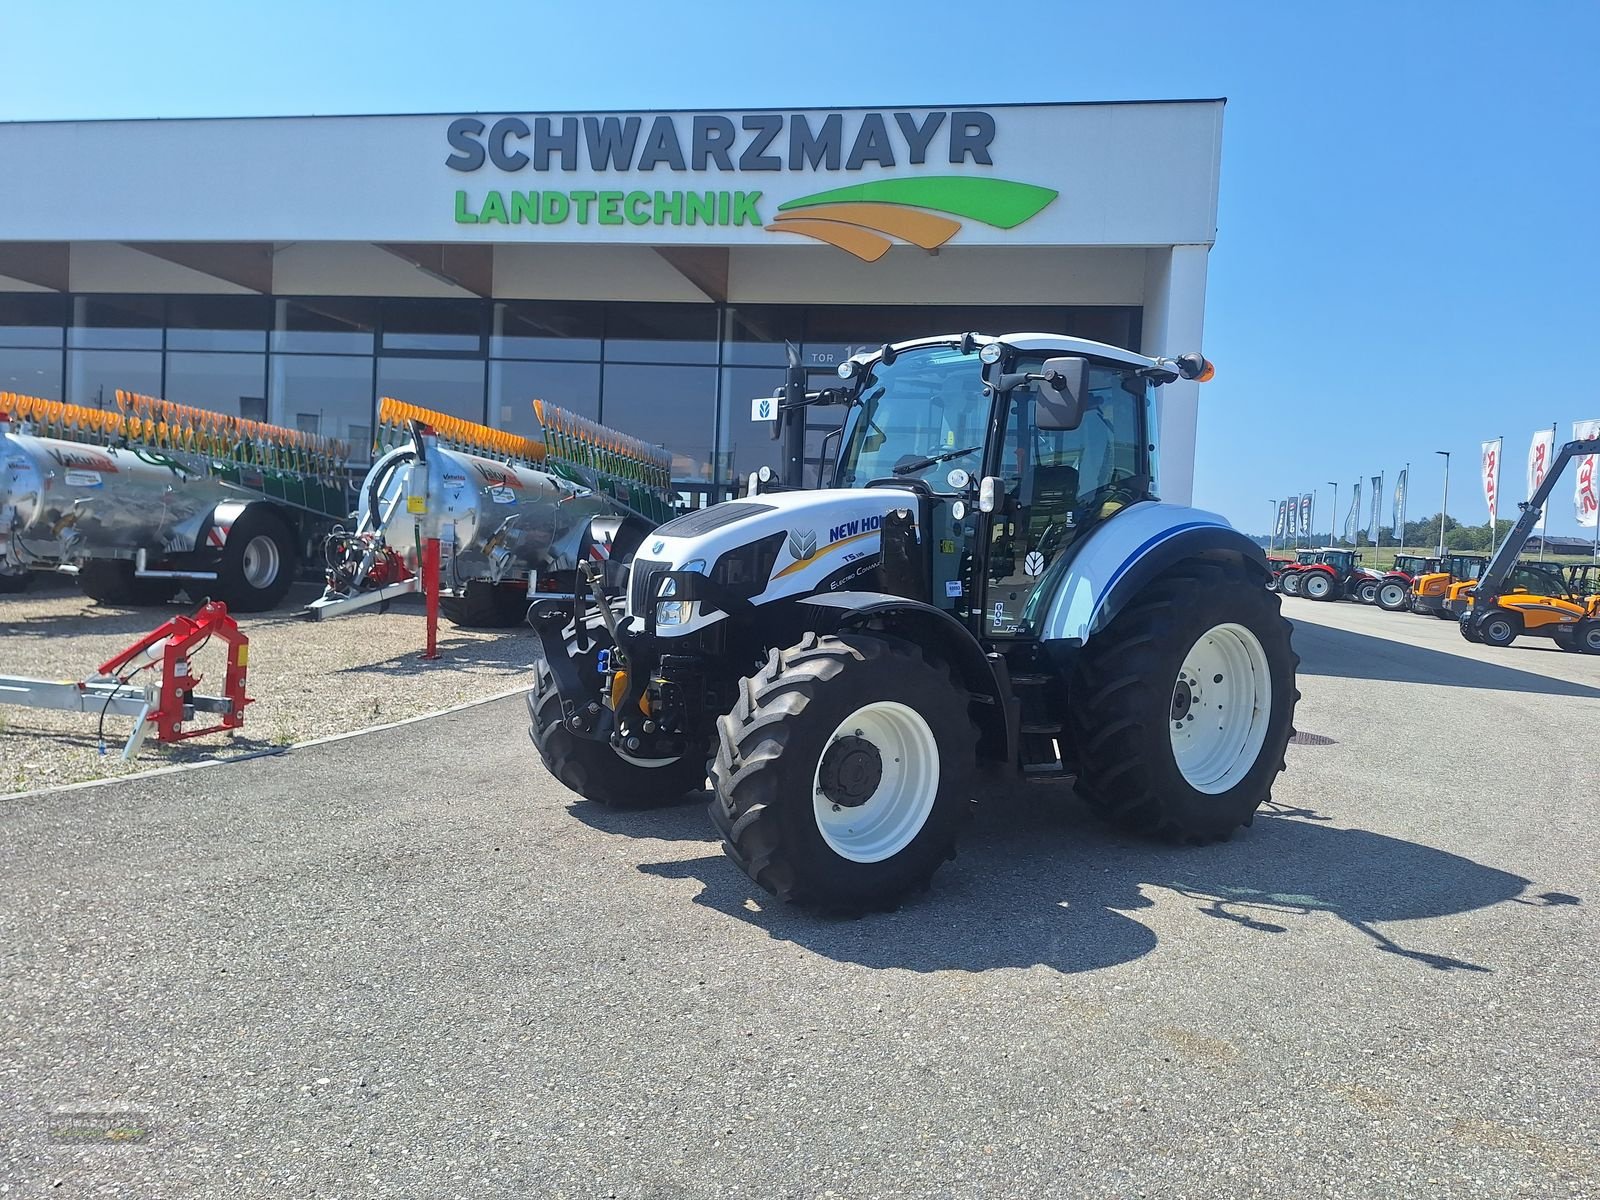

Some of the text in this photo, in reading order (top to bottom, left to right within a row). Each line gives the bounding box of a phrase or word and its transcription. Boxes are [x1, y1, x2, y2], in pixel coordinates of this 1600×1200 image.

[445, 111, 996, 172] SCHWARZMAYR
[455, 190, 763, 226] LANDTECHNIK
[811, 353, 834, 362] TOR
[829, 520, 859, 543] NEW
